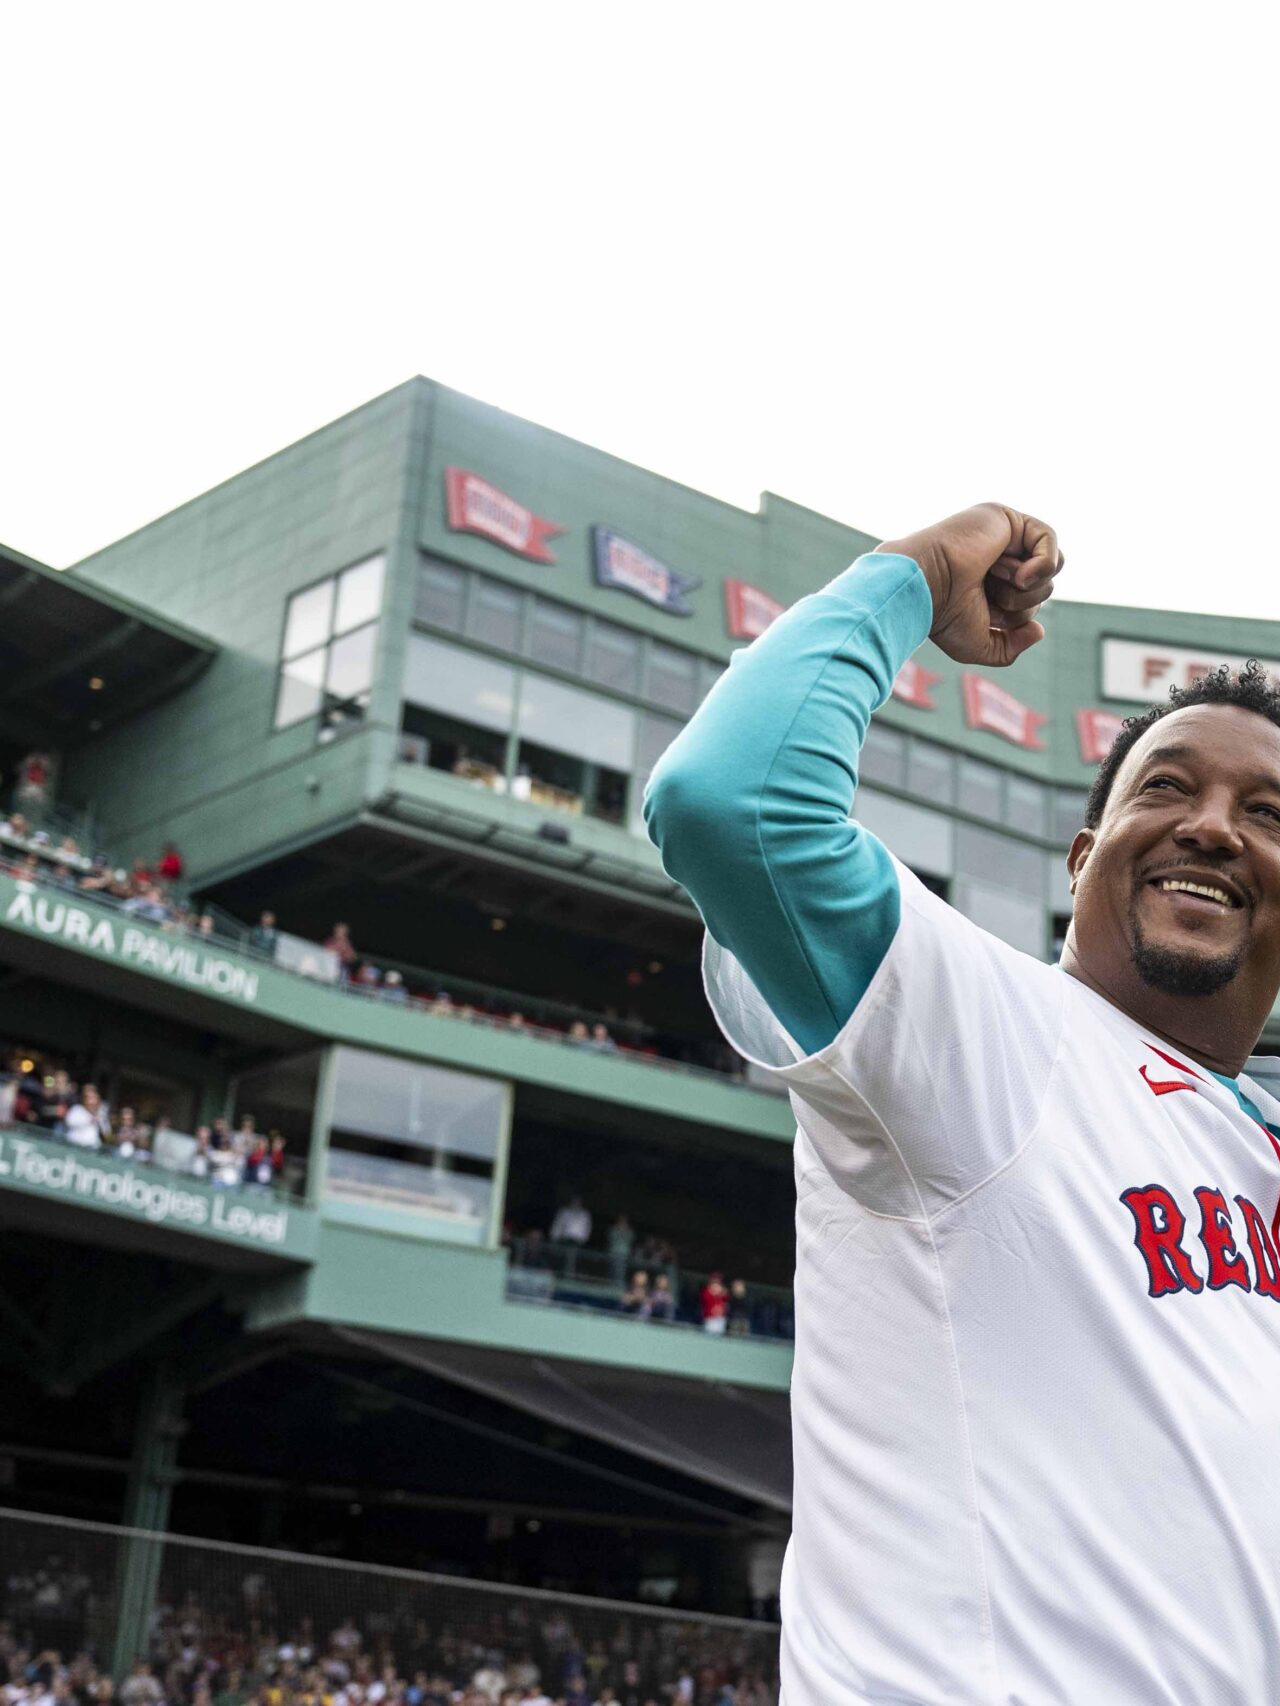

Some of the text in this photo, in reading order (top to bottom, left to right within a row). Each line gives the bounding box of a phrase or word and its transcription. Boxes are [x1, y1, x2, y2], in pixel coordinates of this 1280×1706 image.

[121, 928, 260, 1001] PAVILION
[8, 1138, 209, 1223] Technologies
[211, 1192, 289, 1244] Level
